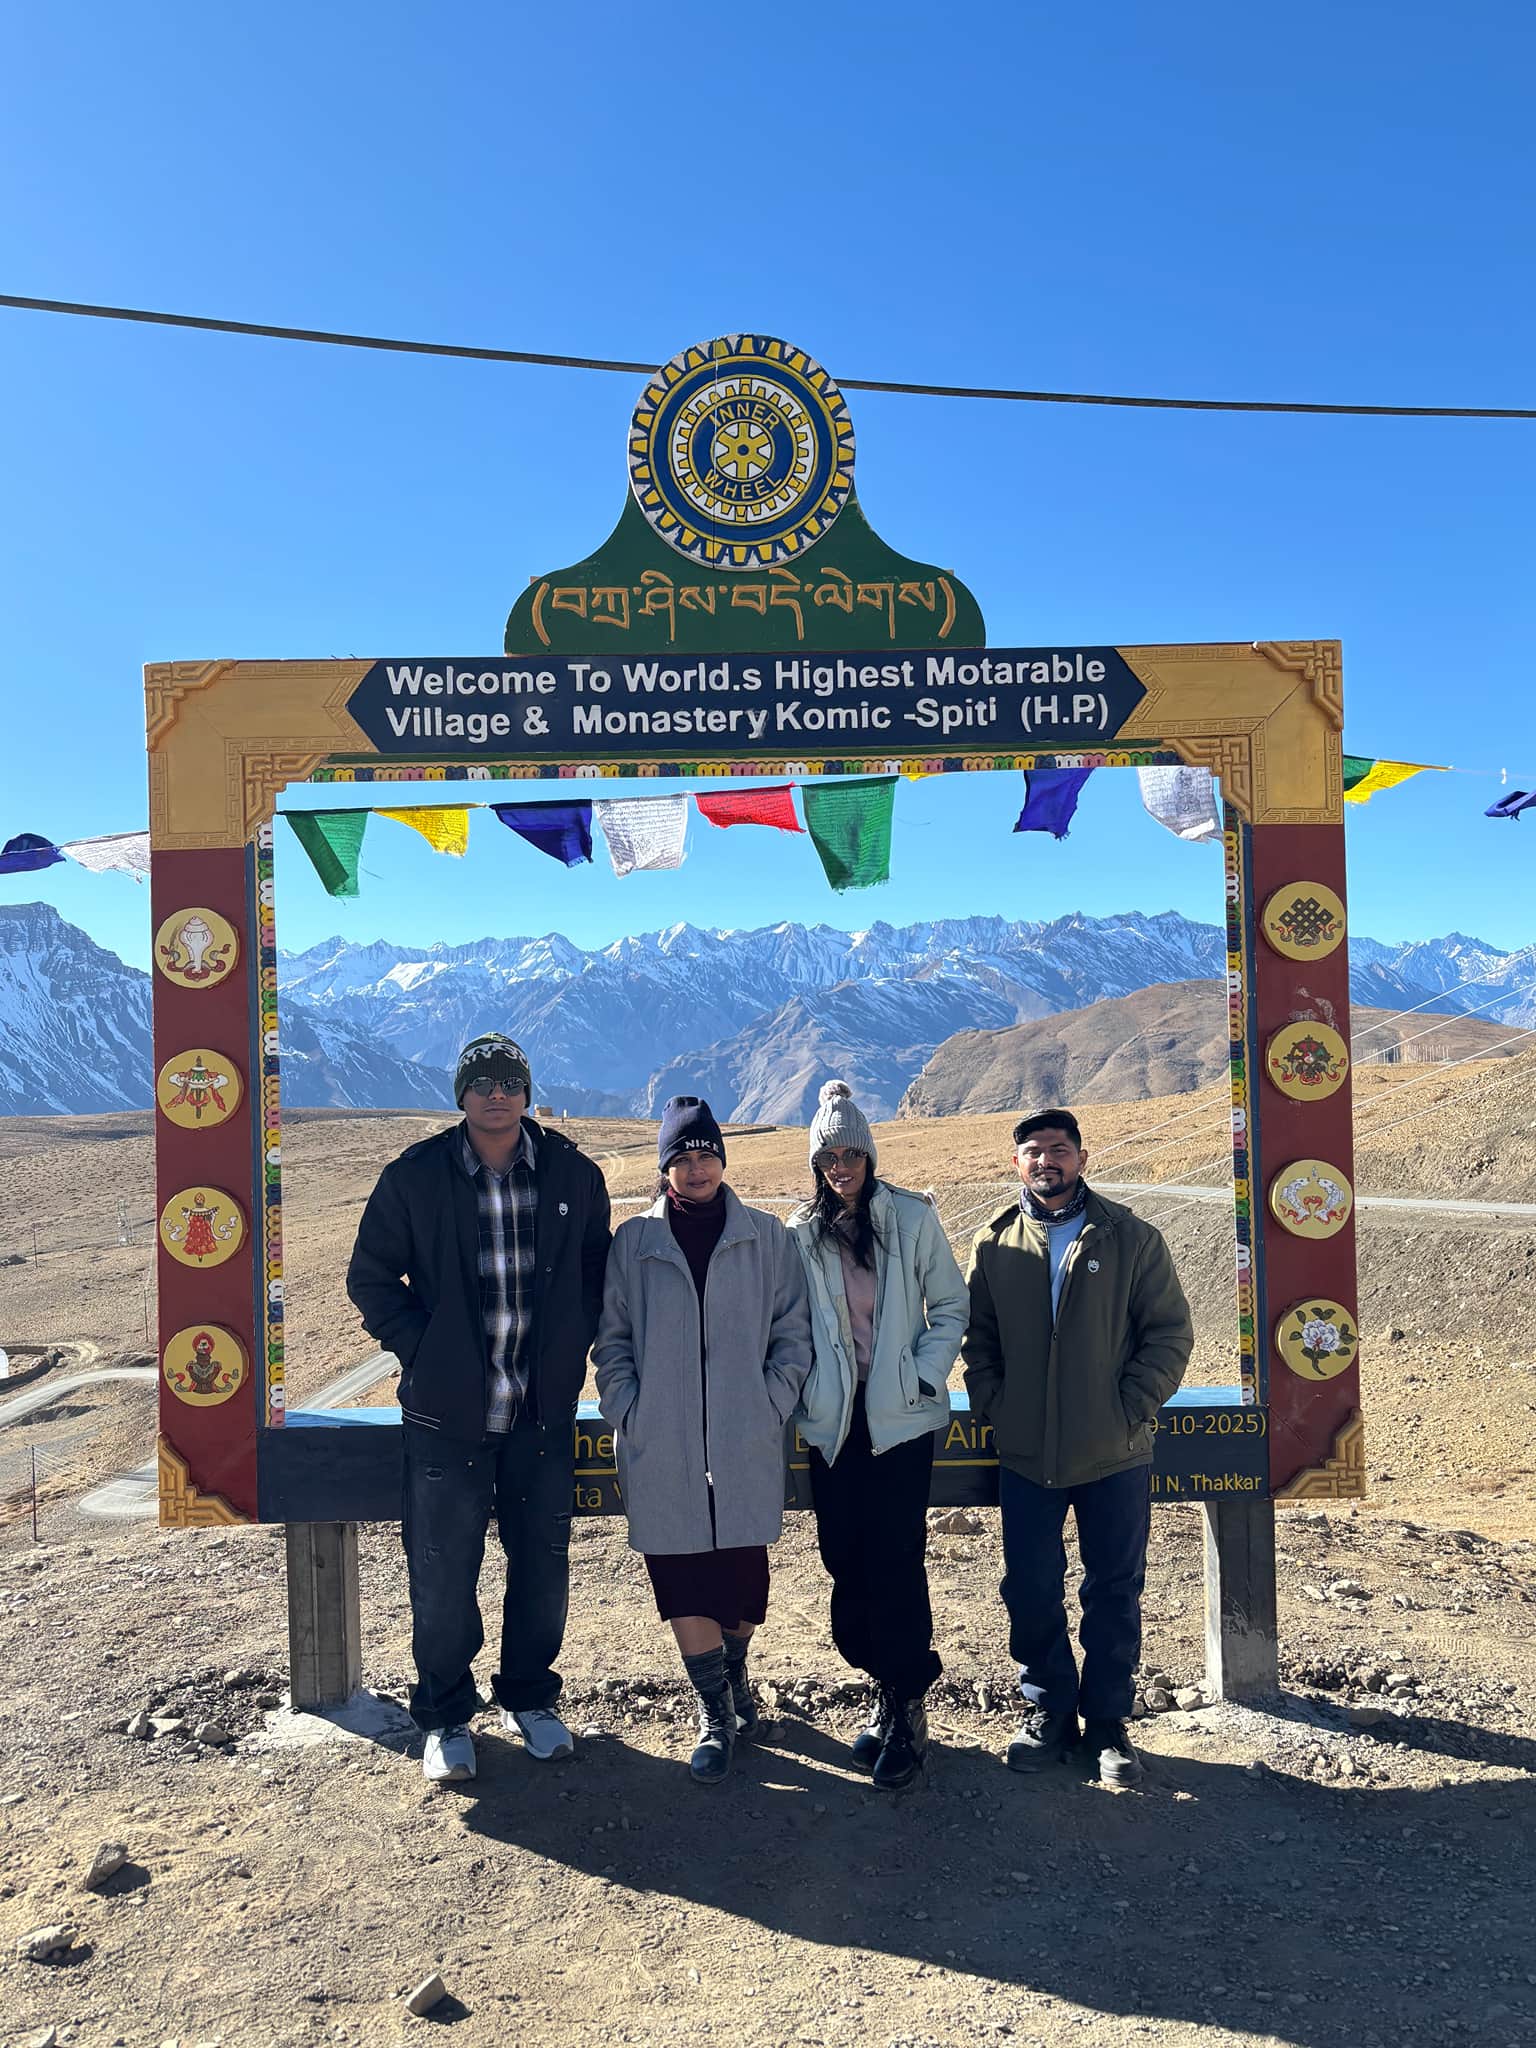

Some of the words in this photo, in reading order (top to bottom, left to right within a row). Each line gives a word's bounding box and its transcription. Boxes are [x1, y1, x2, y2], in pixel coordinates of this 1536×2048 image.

[708, 402, 779, 430] INNER
[704, 469, 782, 499] WHEEL
[385, 665, 557, 695] Welcome
[567, 663, 612, 693] To
[622, 662, 762, 692] World.s
[775, 659, 915, 697] Highest
[926, 653, 1106, 686] Motarable
[385, 706, 510, 744] Village
[522, 705, 550, 736] &
[572, 704, 768, 739] Monastery
[775, 701, 892, 731] Komic
[903, 697, 997, 735] -Spiti
[1021, 693, 1109, 733] (H.P.)
[685, 1139, 719, 1153] NIKE
[1166, 1475, 1185, 1493] N.
[1190, 1472, 1262, 1492] Thakkar
